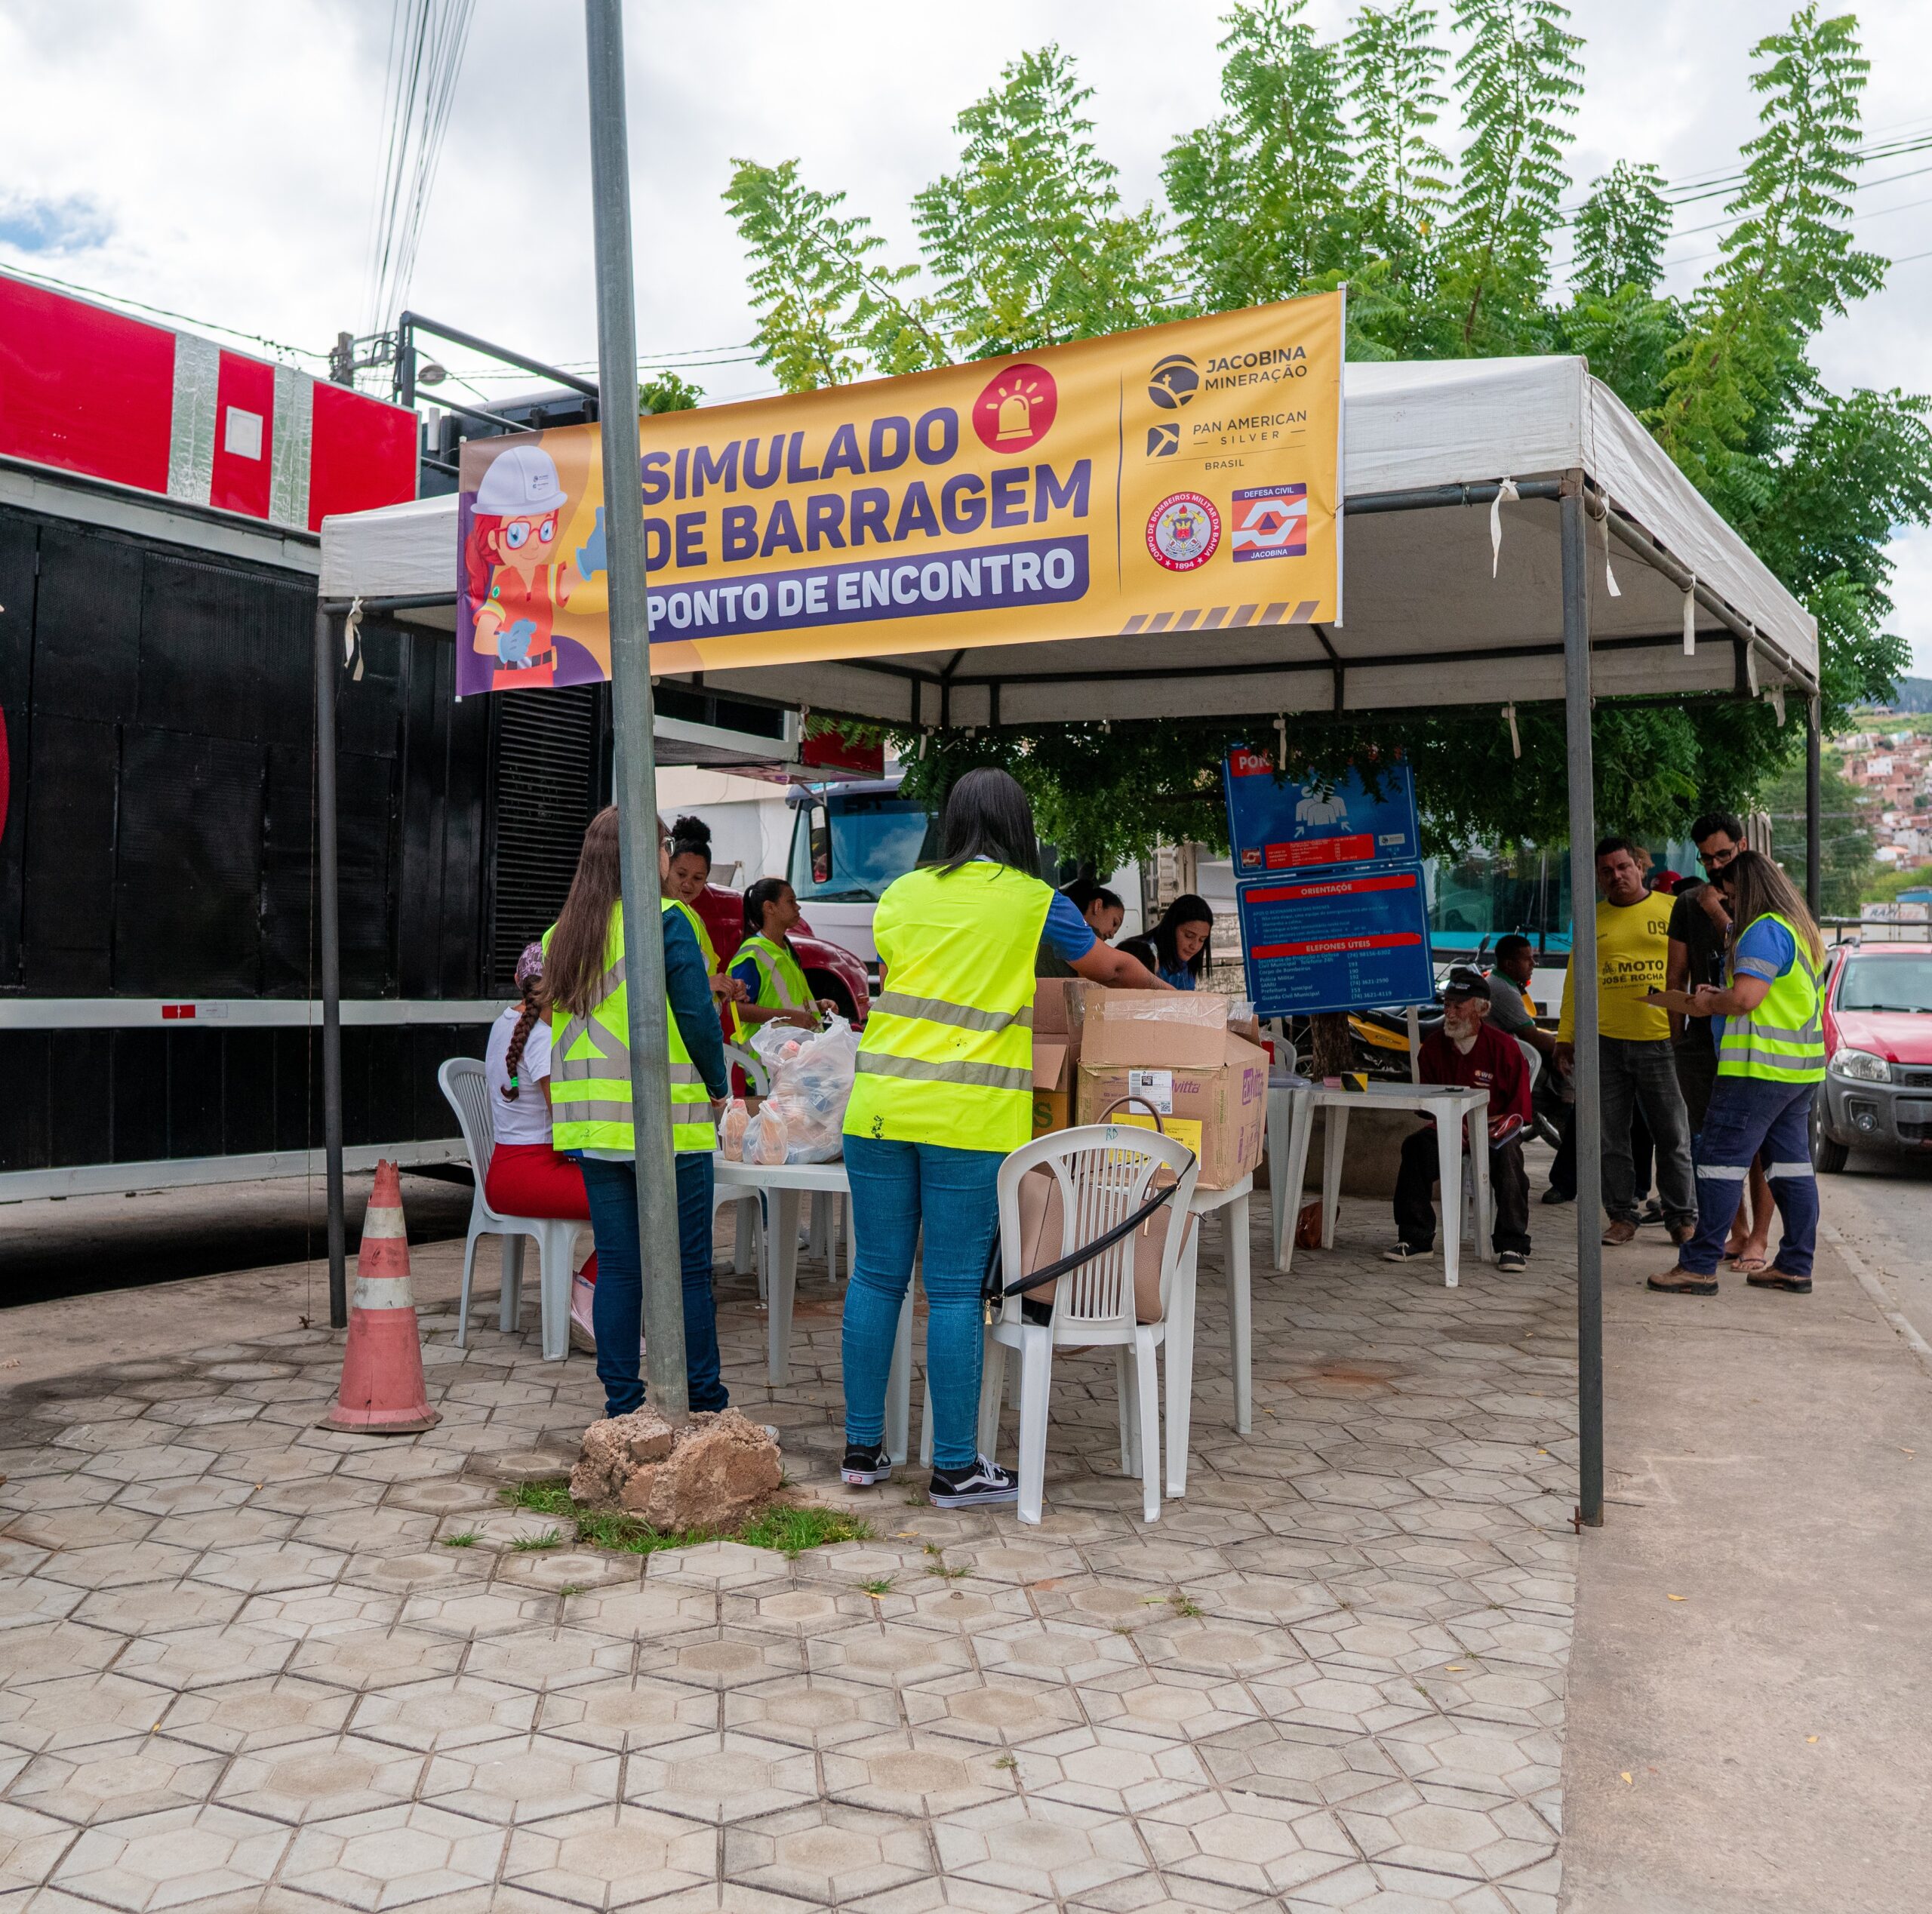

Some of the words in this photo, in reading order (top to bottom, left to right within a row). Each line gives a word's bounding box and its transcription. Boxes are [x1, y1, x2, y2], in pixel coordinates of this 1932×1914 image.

[1206, 346, 1306, 374] JACOBINA
[1205, 363, 1307, 391] MINERAÇÃO
[1193, 420, 1221, 435] PAN
[1226, 410, 1306, 431] AMERICAN
[1220, 431, 1279, 445] SILVER
[642, 408, 958, 505] SIMULADO
[1205, 459, 1244, 470] BRASIL
[1244, 488, 1274, 498] DEFESA
[646, 511, 707, 572] DE
[721, 459, 1092, 562] BARRAGEM
[1152, 494, 1191, 525] BOMBEIROS
[1192, 494, 1217, 518] MILITAR
[1147, 524, 1155, 534] DE
[1213, 519, 1220, 531] DA
[1148, 537, 1163, 562] CORPO
[1203, 532, 1220, 557] BAHIA
[1251, 549, 1287, 559] JACOBINA
[1174, 561, 1195, 570] 1894
[648, 582, 768, 632] PONTO
[778, 575, 828, 617] DE
[837, 548, 1075, 611] ENCONTRO
[1348, 940, 1371, 949] ÚTEIS
[1618, 960, 1664, 973] MOTO
[1602, 974, 1627, 985] JOSÉ
[1631, 973, 1664, 982] ROCHA
